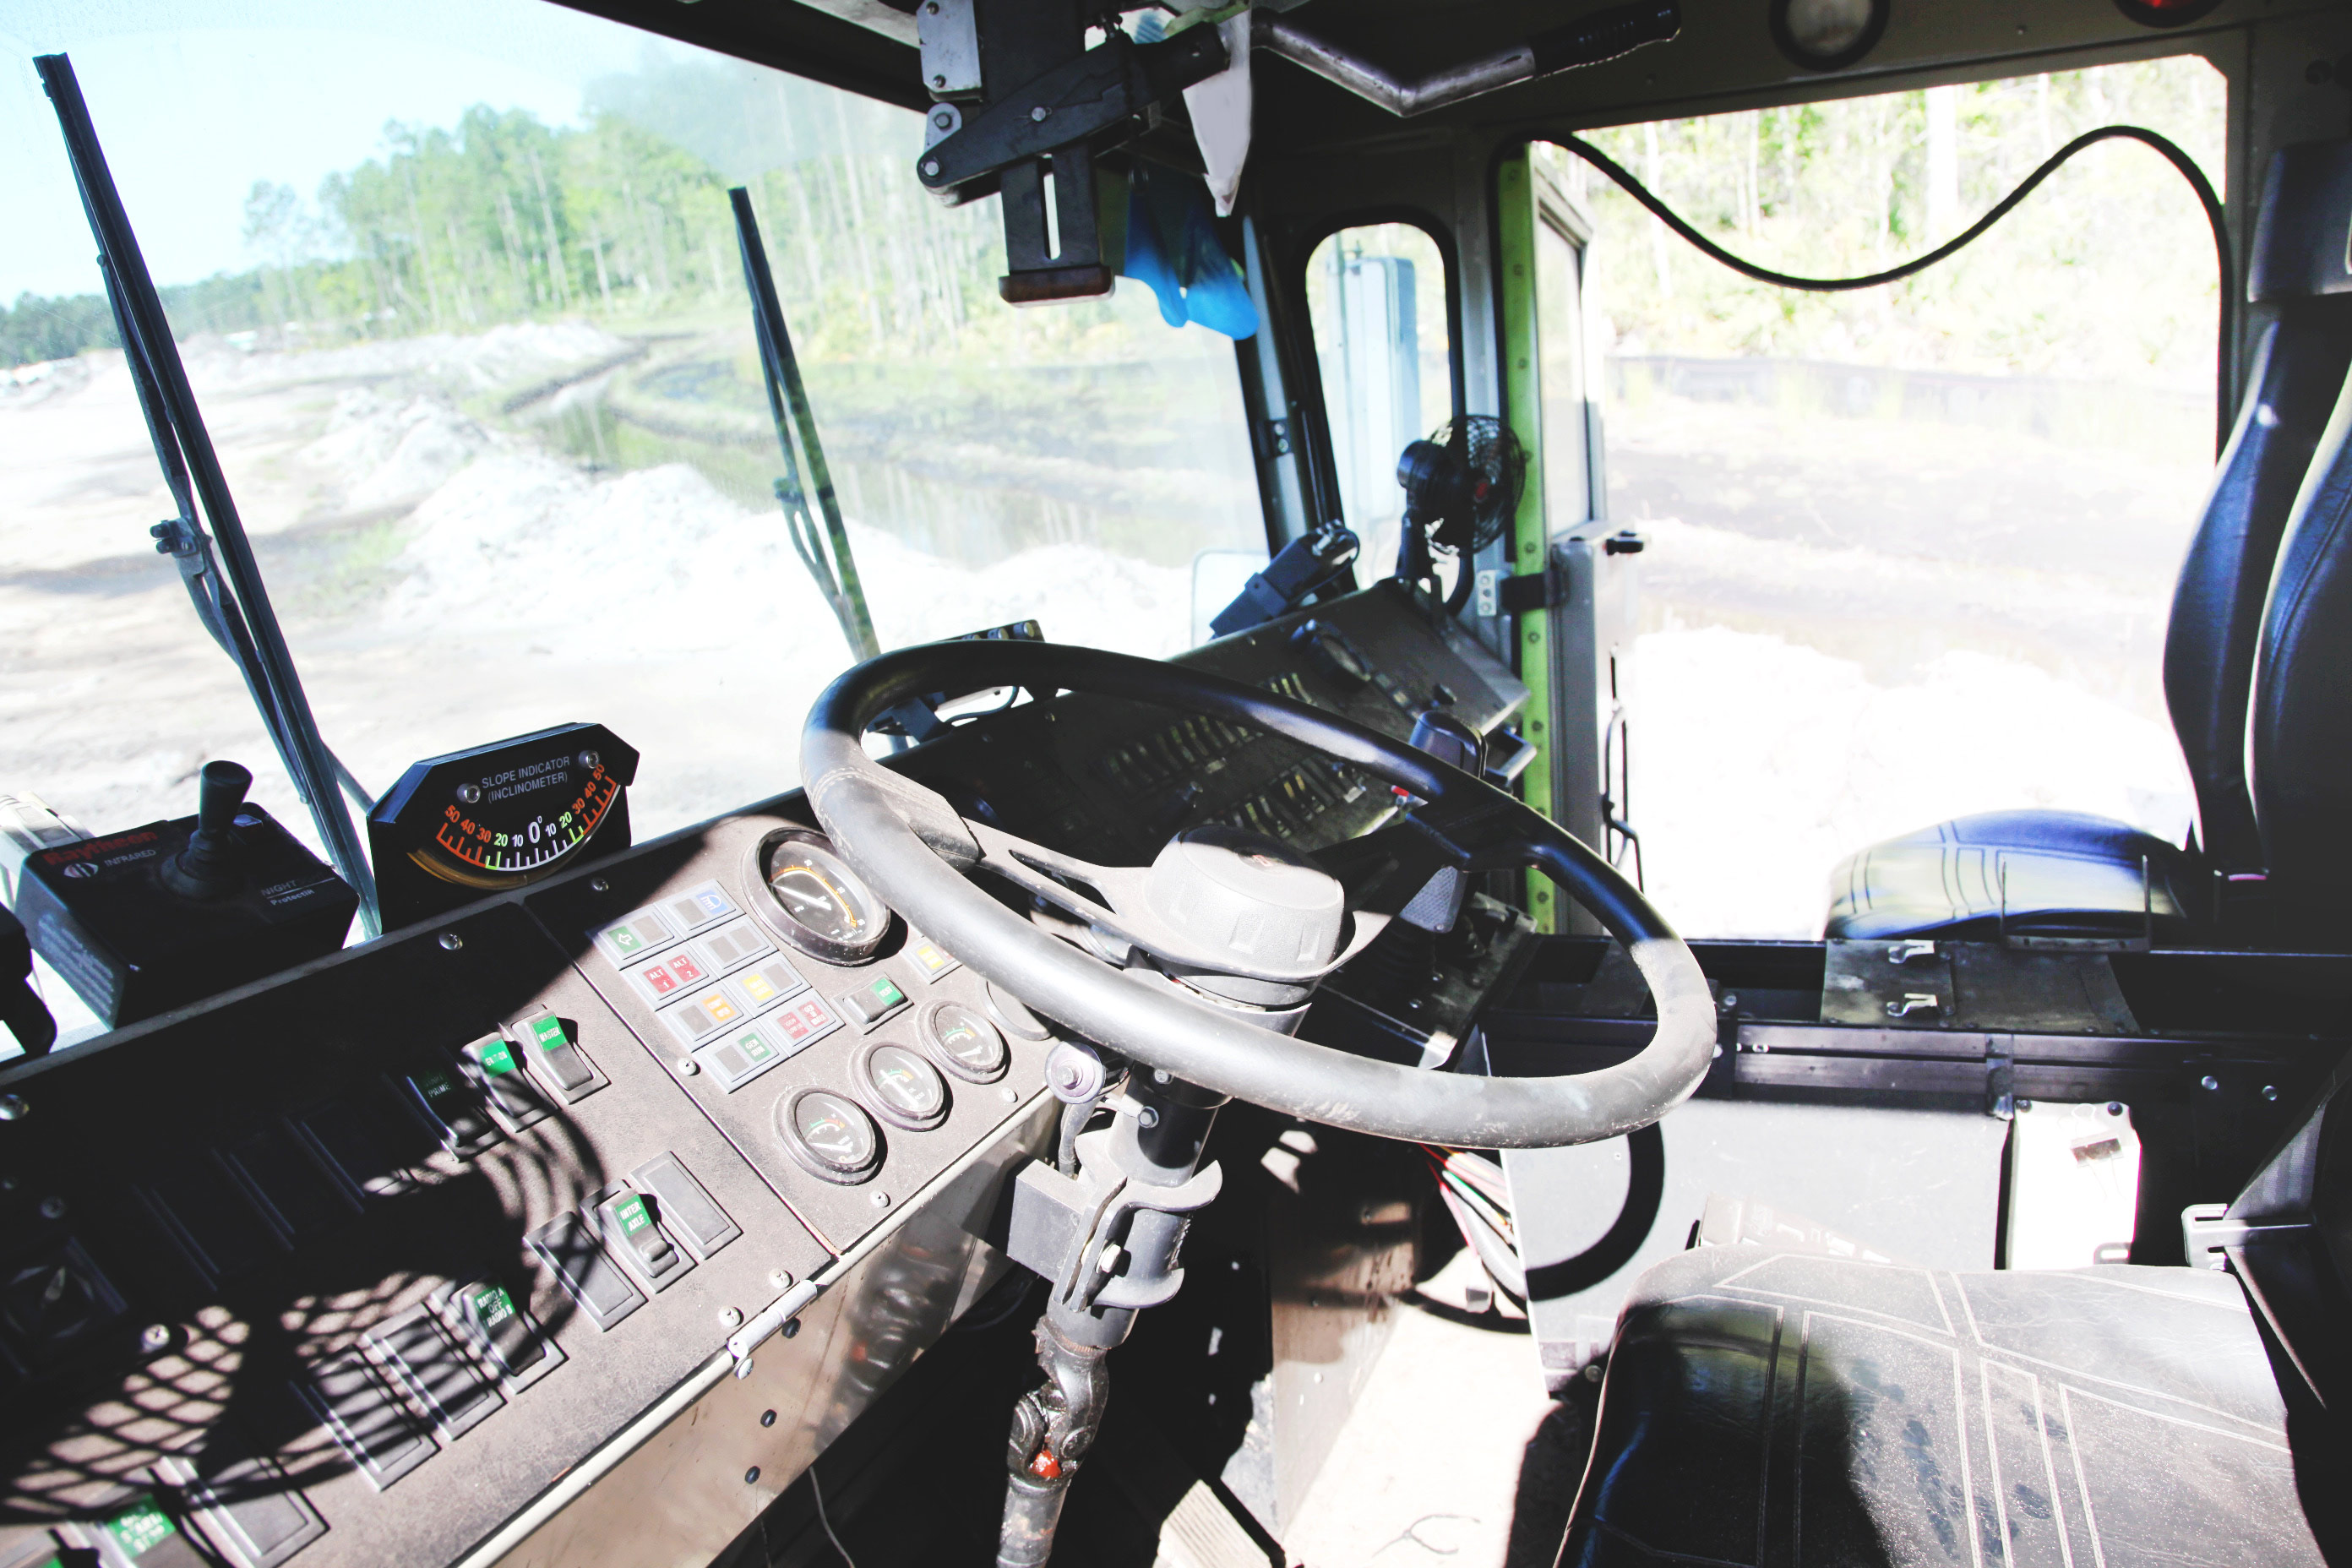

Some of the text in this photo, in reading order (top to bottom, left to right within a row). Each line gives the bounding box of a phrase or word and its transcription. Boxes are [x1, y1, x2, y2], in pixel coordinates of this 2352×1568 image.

[481, 755, 571, 790] SLOPE INDICATOR
[487, 771, 569, 803] (INCLINOMETER)
[444, 804, 460, 823] 50
[460, 818, 476, 836] 40
[476, 827, 492, 843] 30
[493, 832, 508, 847] 20
[511, 834, 524, 847] 10
[545, 822, 557, 838] 10
[558, 811, 573, 829] 20
[571, 798, 586, 815] 30
[584, 781, 596, 798] 40
[592, 763, 605, 781] 50
[41, 831, 159, 866] Raytheon
[104, 848, 156, 867] INFRARED
[672, 957, 688, 969] ALT
[649, 968, 664, 980] ALT
[744, 1038, 760, 1051] GEN
[750, 1044, 765, 1057] RUN
[427, 1082, 451, 1098] PRIME
[619, 1201, 642, 1220] INTER
[628, 1213, 645, 1231] AXLE
[476, 1287, 505, 1309] RADIO A
[487, 1298, 503, 1314] OFF
[487, 1308, 508, 1327] RADIO
